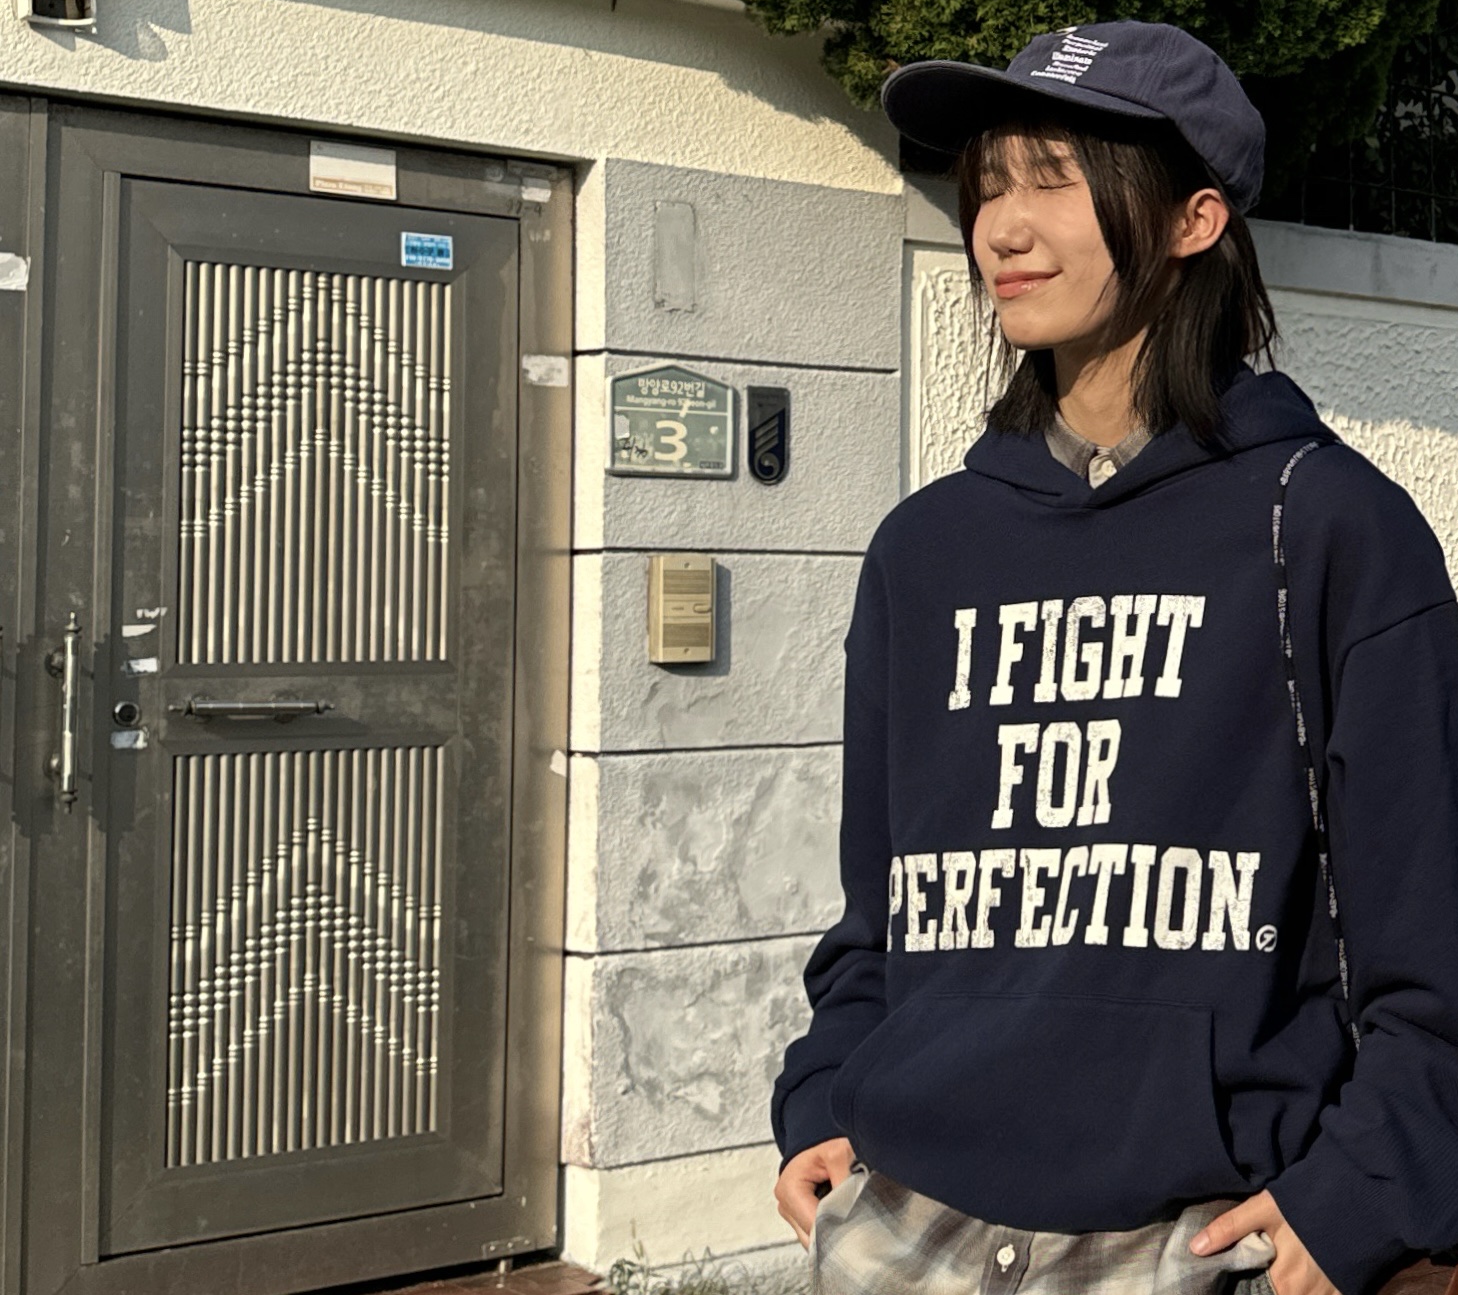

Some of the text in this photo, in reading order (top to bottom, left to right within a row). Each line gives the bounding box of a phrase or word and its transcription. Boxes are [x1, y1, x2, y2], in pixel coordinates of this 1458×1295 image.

[638, 378, 706, 398] 망양로92번길
[654, 420, 688, 461] 3
[948, 608, 977, 711] I
[989, 594, 1206, 706] FIGHT
[991, 718, 1122, 830] FOR
[887, 843, 1261, 952] PERFECTION
